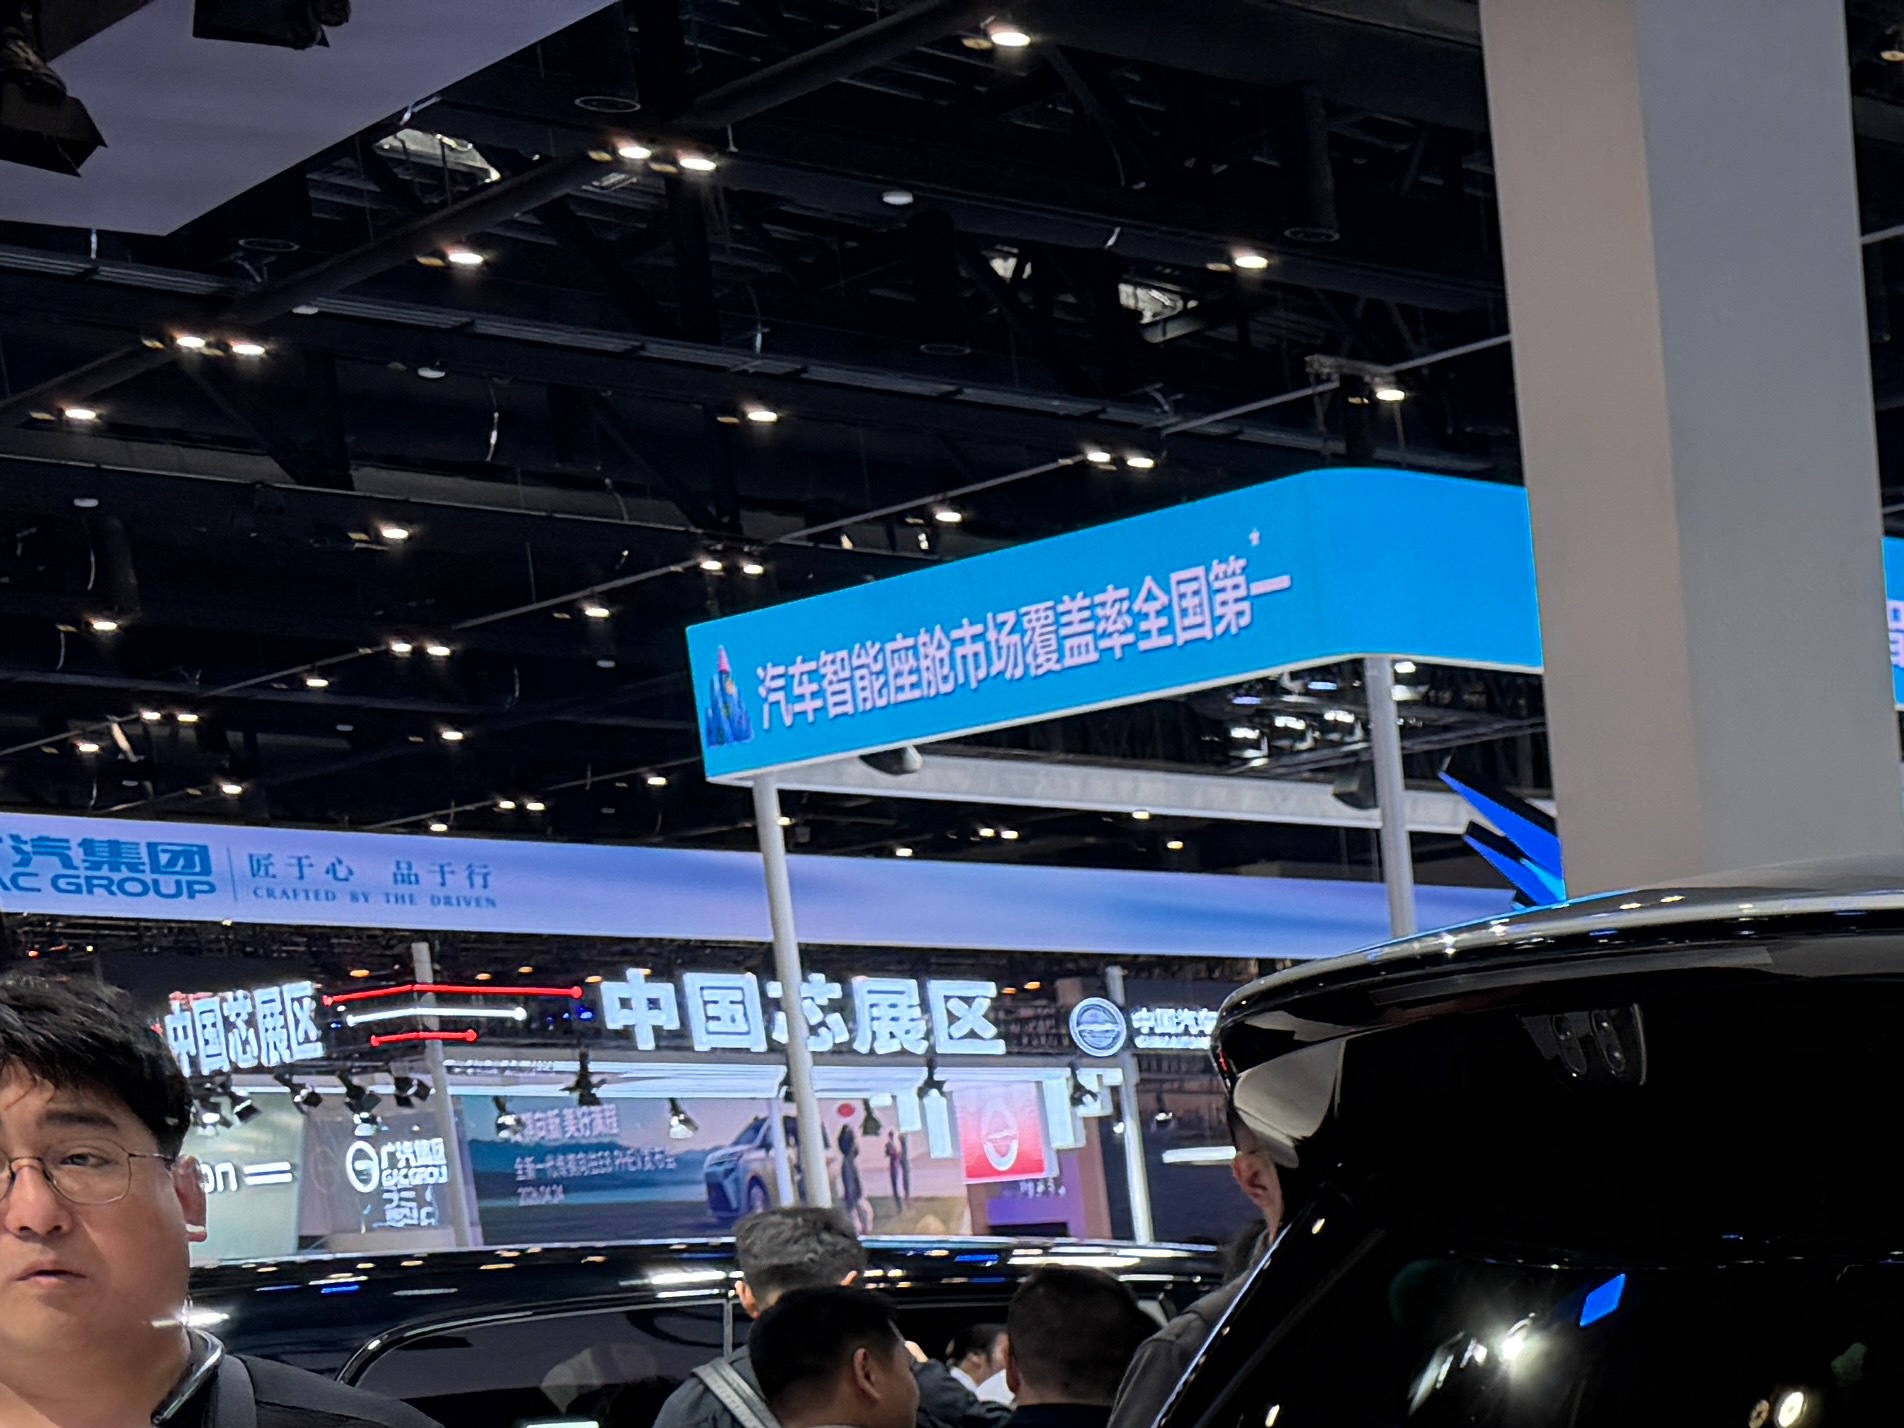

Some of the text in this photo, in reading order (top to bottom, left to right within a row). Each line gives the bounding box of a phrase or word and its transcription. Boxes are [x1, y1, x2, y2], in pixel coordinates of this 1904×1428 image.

[756, 554, 1293, 731] 汽车智能座舱市场覆盖率全国第一
[0, 833, 212, 876] 汽集团
[0, 871, 217, 900] C GROUP
[252, 886, 498, 909] CRAFTED BY THE DRIVEN
[164, 981, 325, 1078] 中国芯展区
[600, 967, 1007, 1055] 中国芯展区
